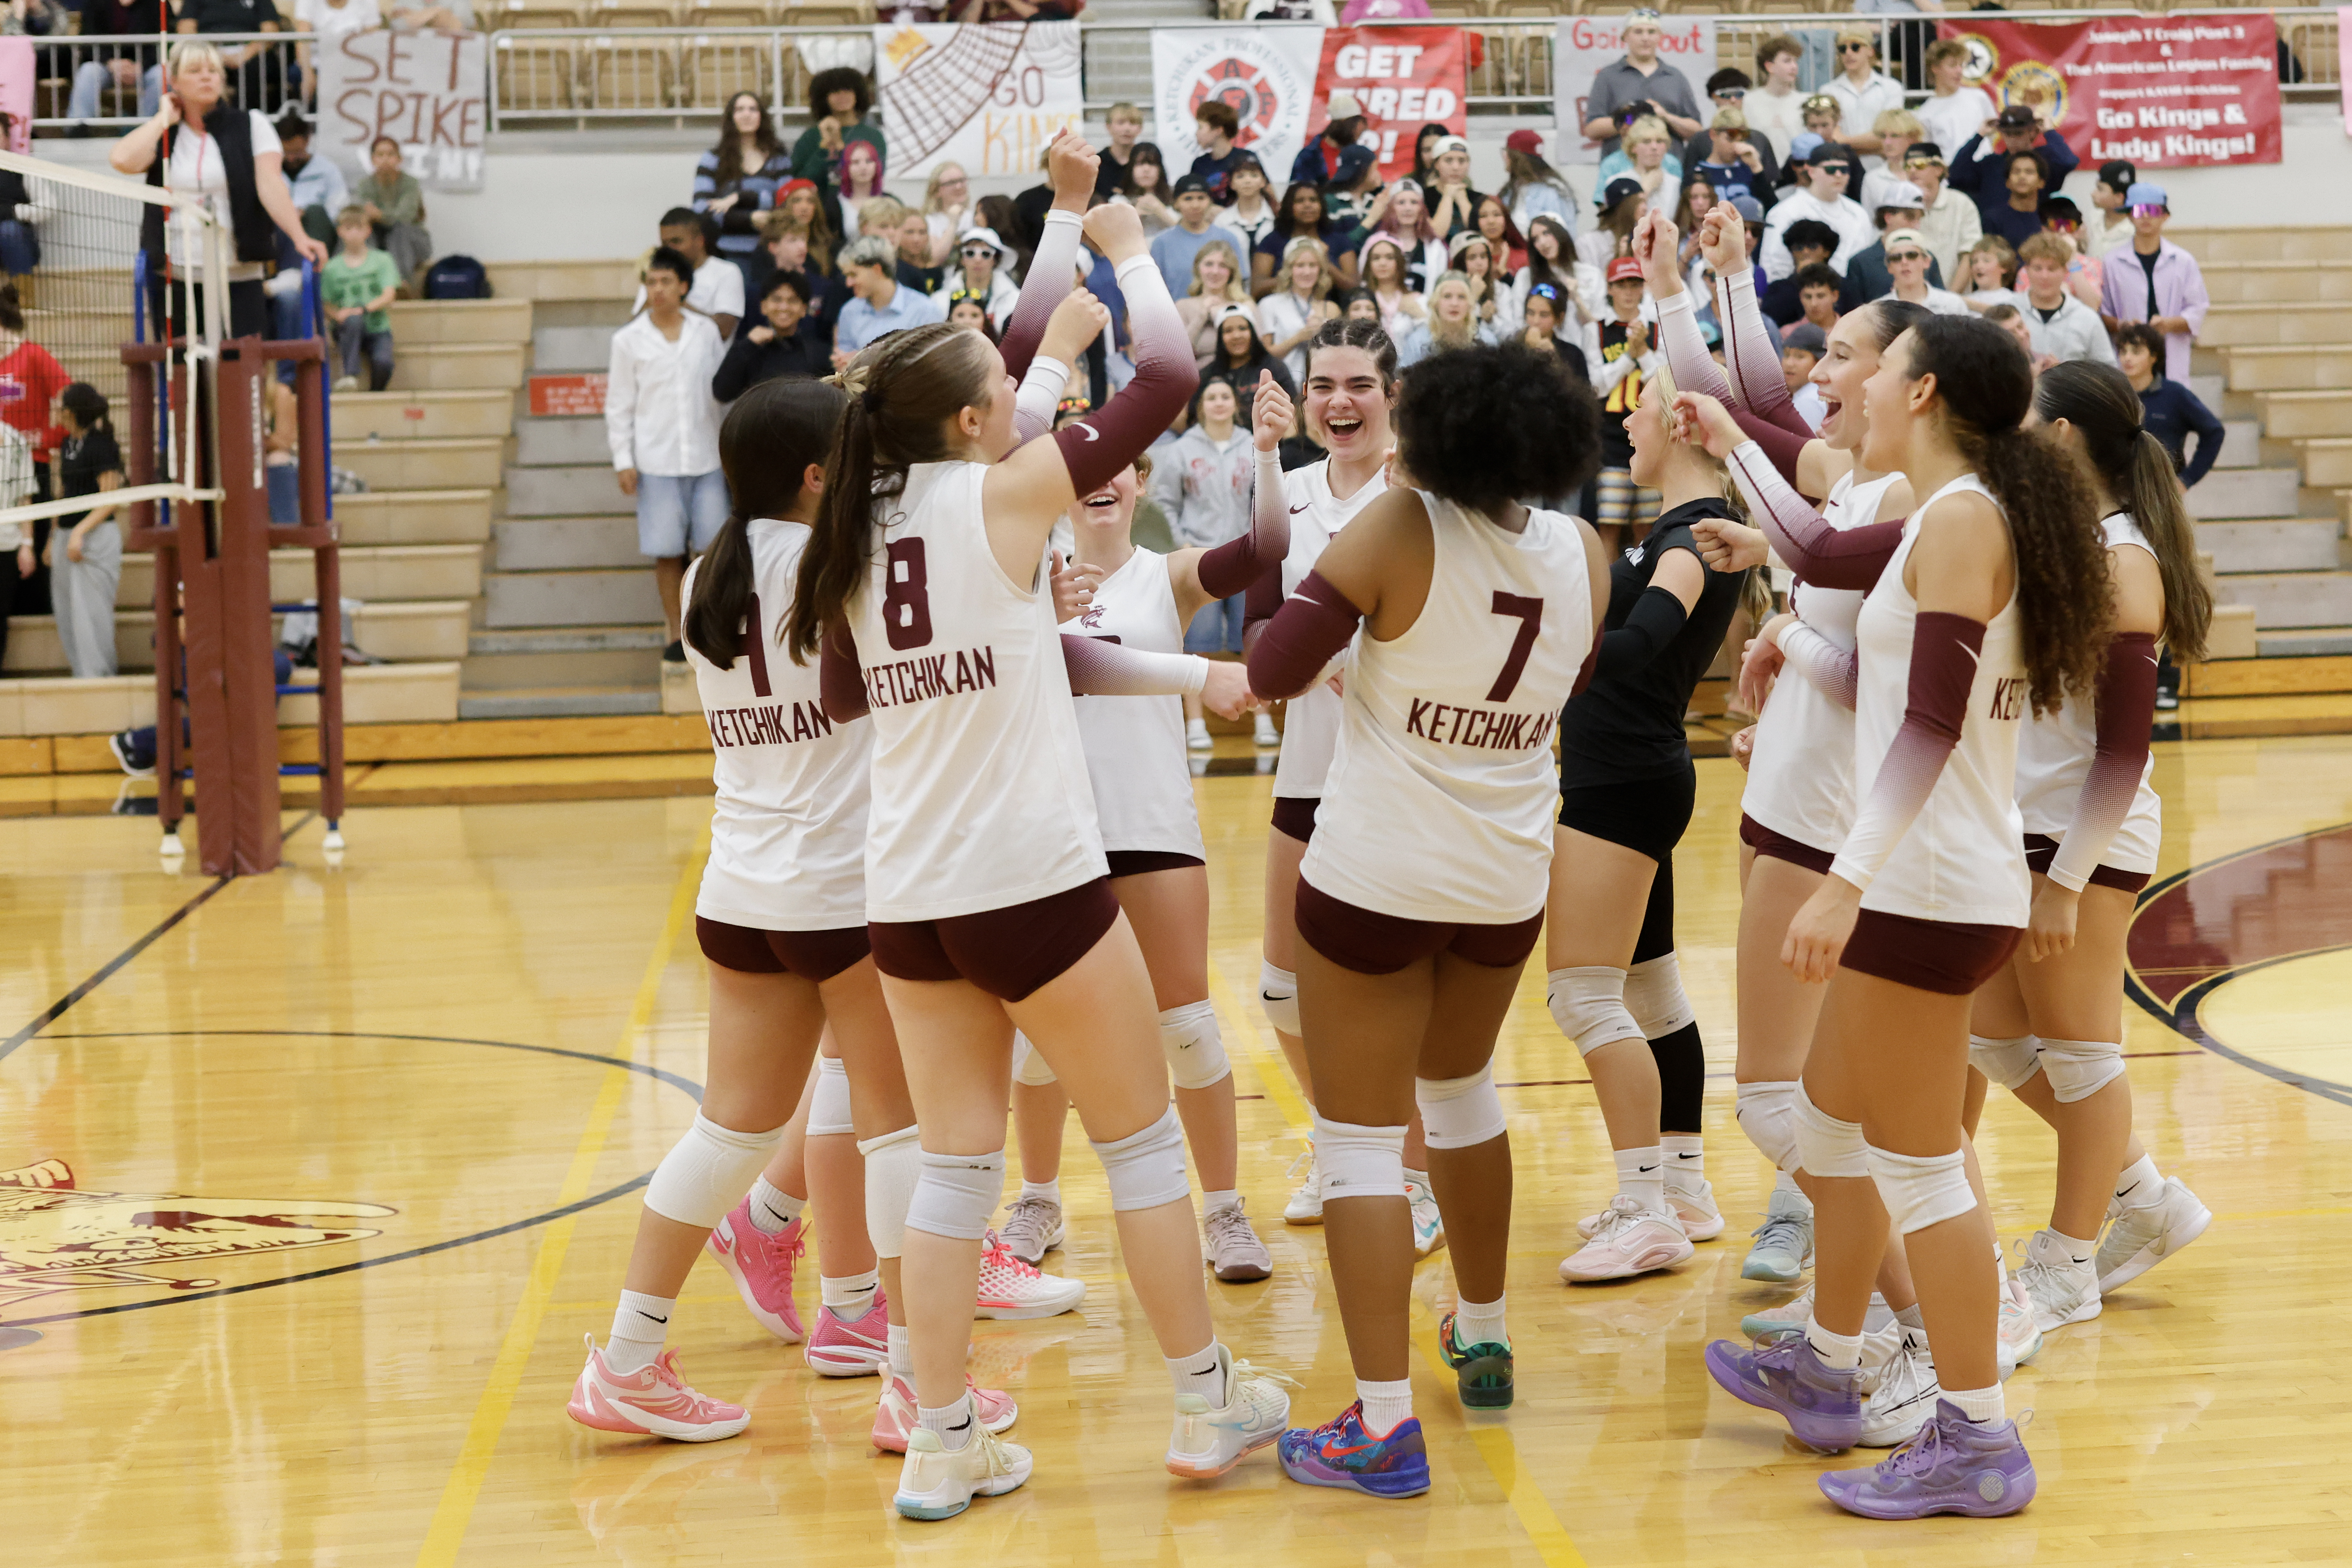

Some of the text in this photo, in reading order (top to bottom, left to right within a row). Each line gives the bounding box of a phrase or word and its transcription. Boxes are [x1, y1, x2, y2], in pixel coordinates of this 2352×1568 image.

[341, 30, 478, 91] SET
[992, 66, 1044, 108] GO
[1335, 44, 1423, 79] GET
[336, 89, 482, 148] SPIKE
[2097, 104, 2248, 130] Go Kings &
[2091, 132, 2255, 162] Lady Kings!
[882, 536, 933, 651] 8
[1485, 590, 1544, 703] 7
[863, 645, 996, 708] KETCHIKAN
[707, 697, 832, 747] KETCHIKAN
[1406, 697, 1559, 750] KETCHIKAN
